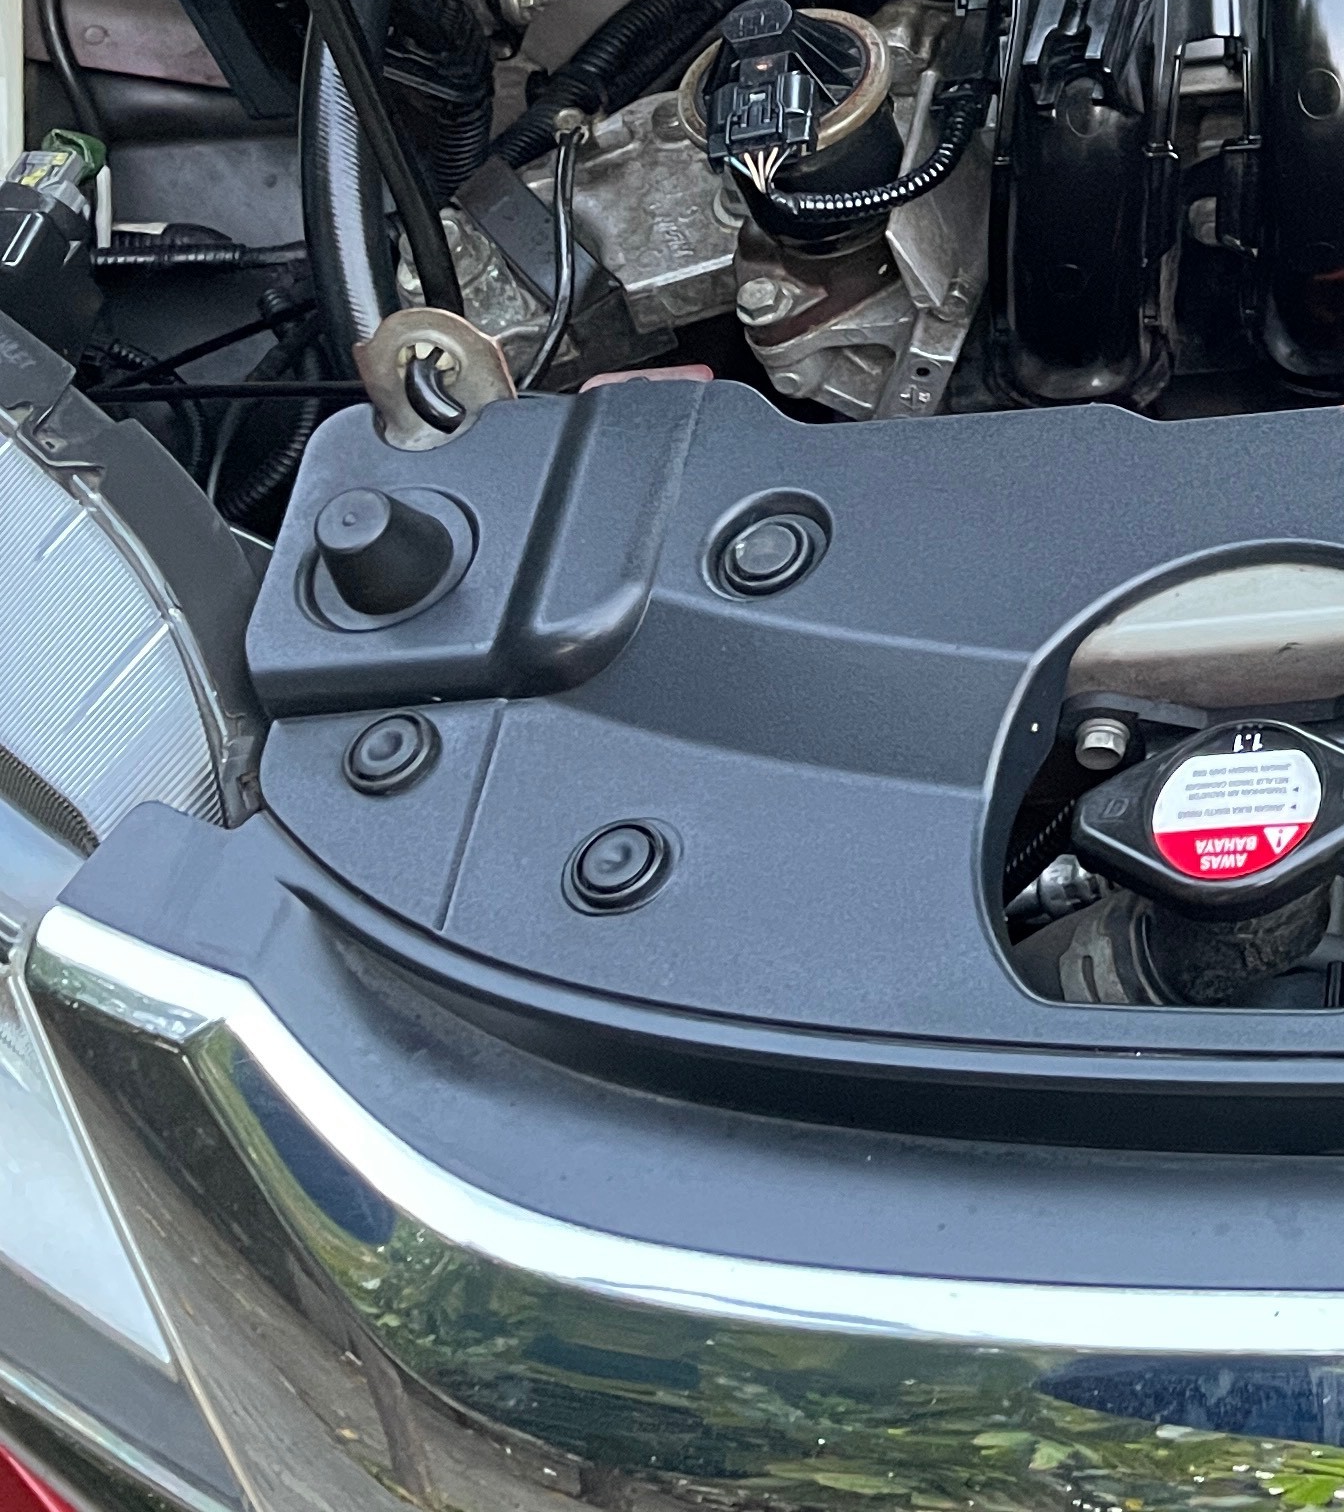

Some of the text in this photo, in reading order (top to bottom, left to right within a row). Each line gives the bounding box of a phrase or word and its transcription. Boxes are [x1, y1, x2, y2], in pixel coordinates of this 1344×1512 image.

[1233, 733, 1263, 752] 1.1
[1195, 835, 1258, 854] BAHAYA
[1200, 853, 1247, 870] AWAS
